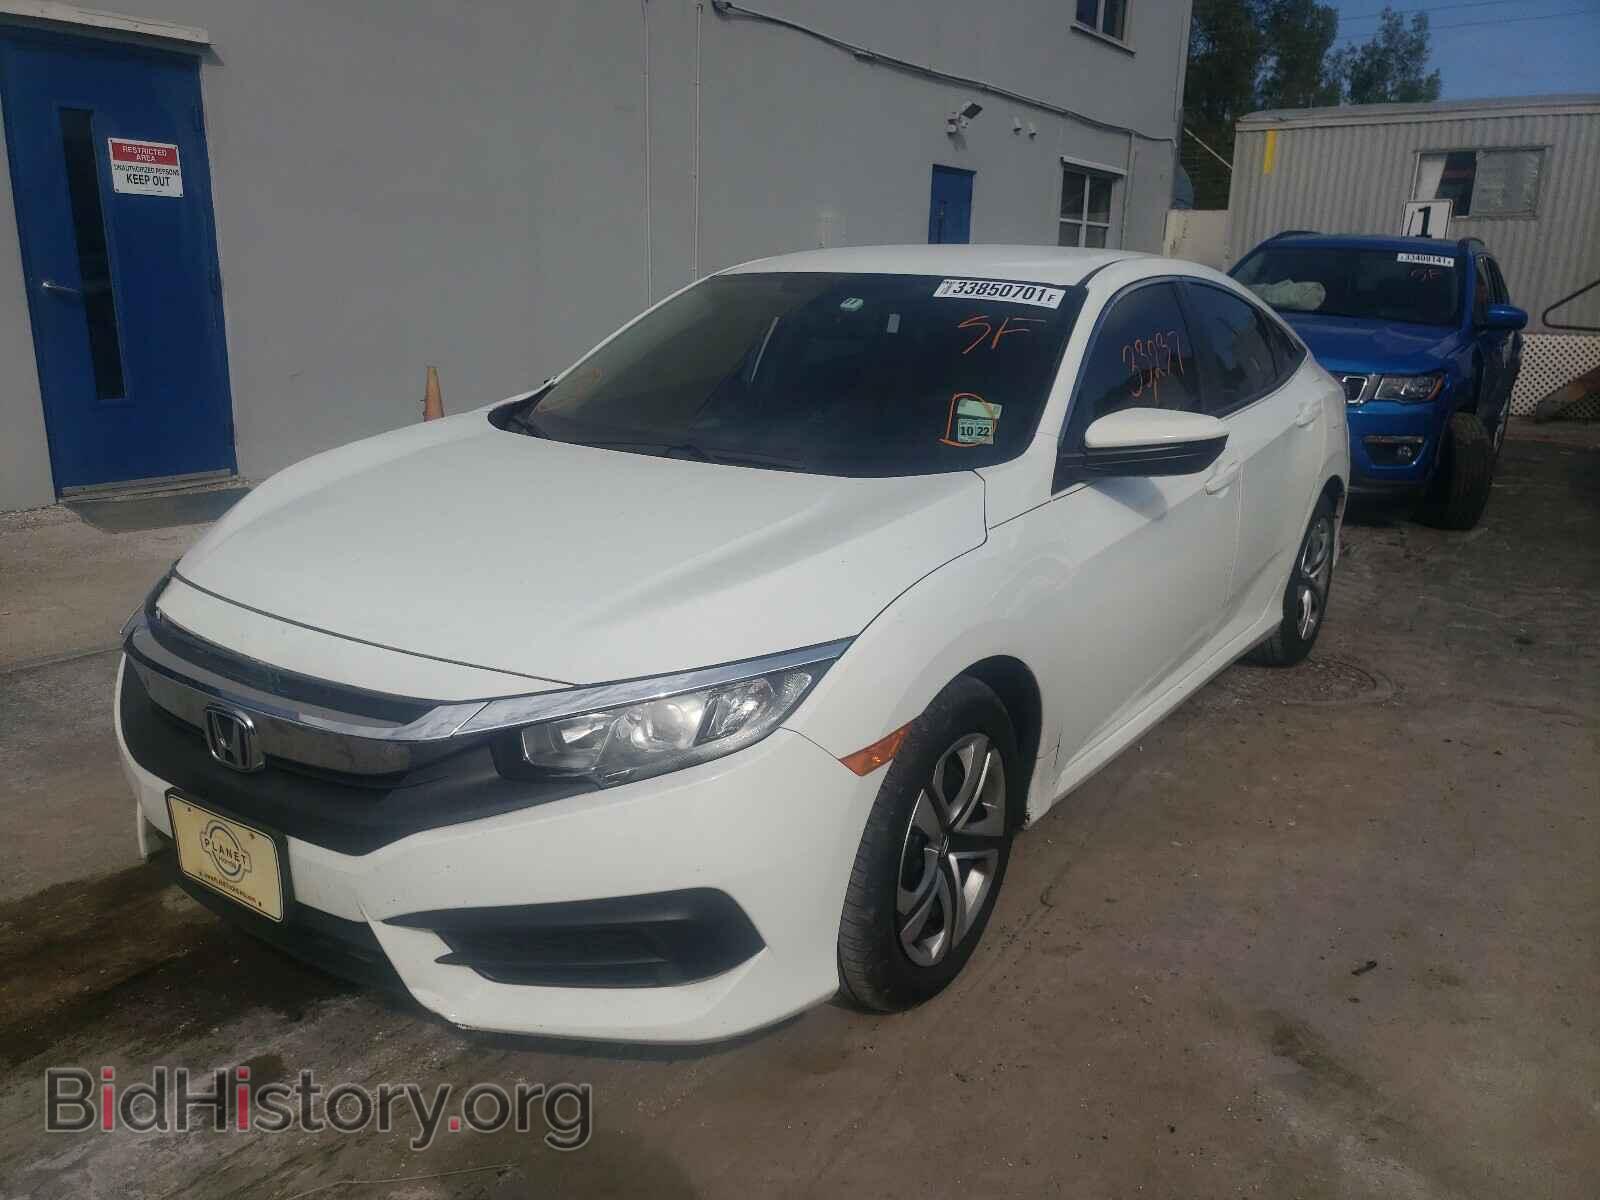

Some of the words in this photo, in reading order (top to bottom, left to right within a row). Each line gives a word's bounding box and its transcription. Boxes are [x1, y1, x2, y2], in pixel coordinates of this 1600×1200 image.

[122, 145, 167, 157] RESTRICTED
[136, 154, 156, 162] AREA
[113, 163, 155, 174] UNAUTHORIZED
[155, 168, 180, 176] PERSONS
[126, 173, 150, 185] KEEP
[152, 175, 171, 187] OUT
[952, 280, 1047, 303] 33850701
[960, 426, 974, 437] 10
[976, 426, 990, 437] 22
[205, 837, 247, 866] PLANET
